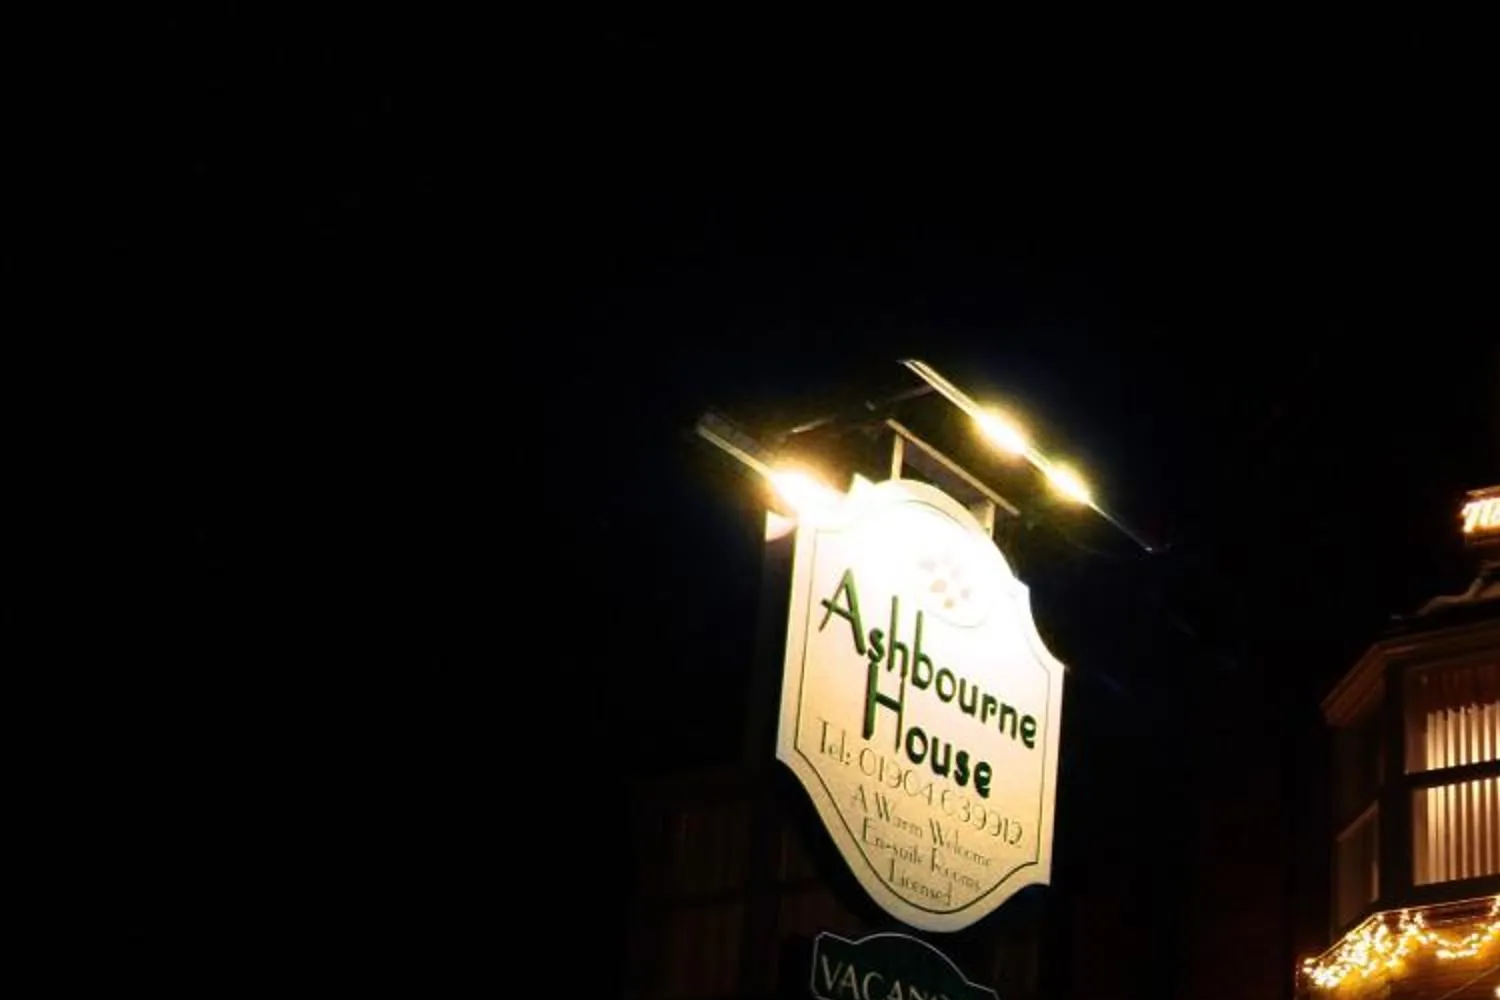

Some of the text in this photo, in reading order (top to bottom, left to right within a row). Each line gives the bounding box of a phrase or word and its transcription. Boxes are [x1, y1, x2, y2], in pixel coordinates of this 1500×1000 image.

[818, 567, 1038, 749] Ashbourne
[862, 661, 994, 799] House
[852, 783, 992, 867] A Warm Welcome
[889, 858, 953, 907] Licensed
[931, 848, 982, 892] Rooms
